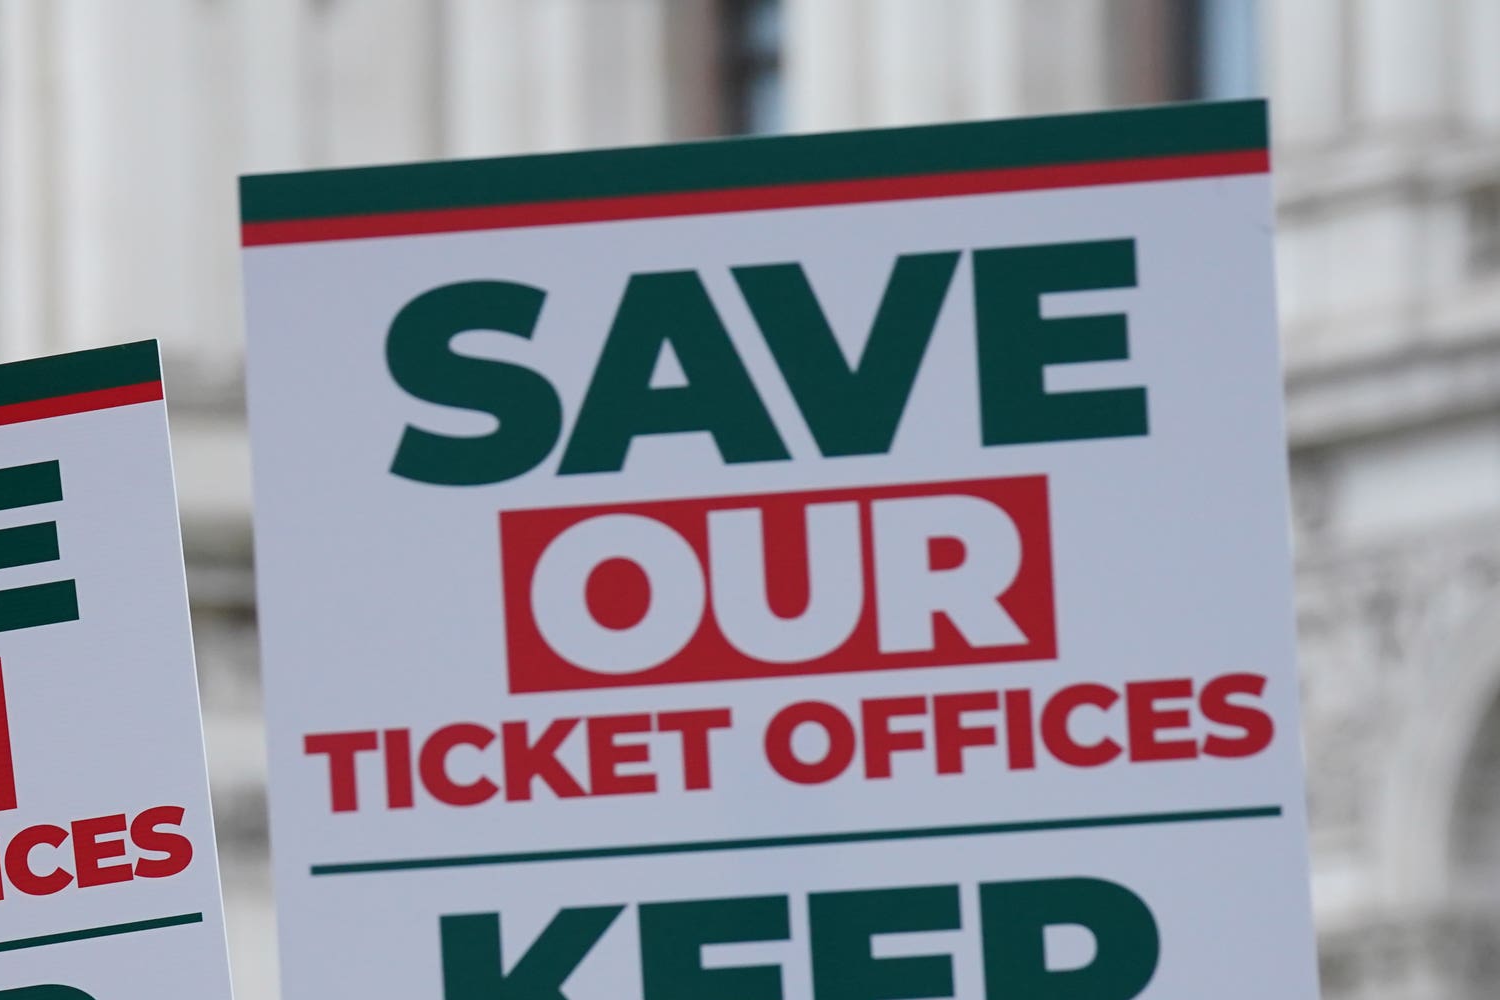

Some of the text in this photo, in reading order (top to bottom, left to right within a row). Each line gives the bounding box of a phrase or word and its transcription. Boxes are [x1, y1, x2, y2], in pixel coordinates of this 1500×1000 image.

[386, 239, 1148, 486] SAVE
[531, 495, 1028, 674] OUR
[305, 674, 1273, 812] TICKET OFFICES
